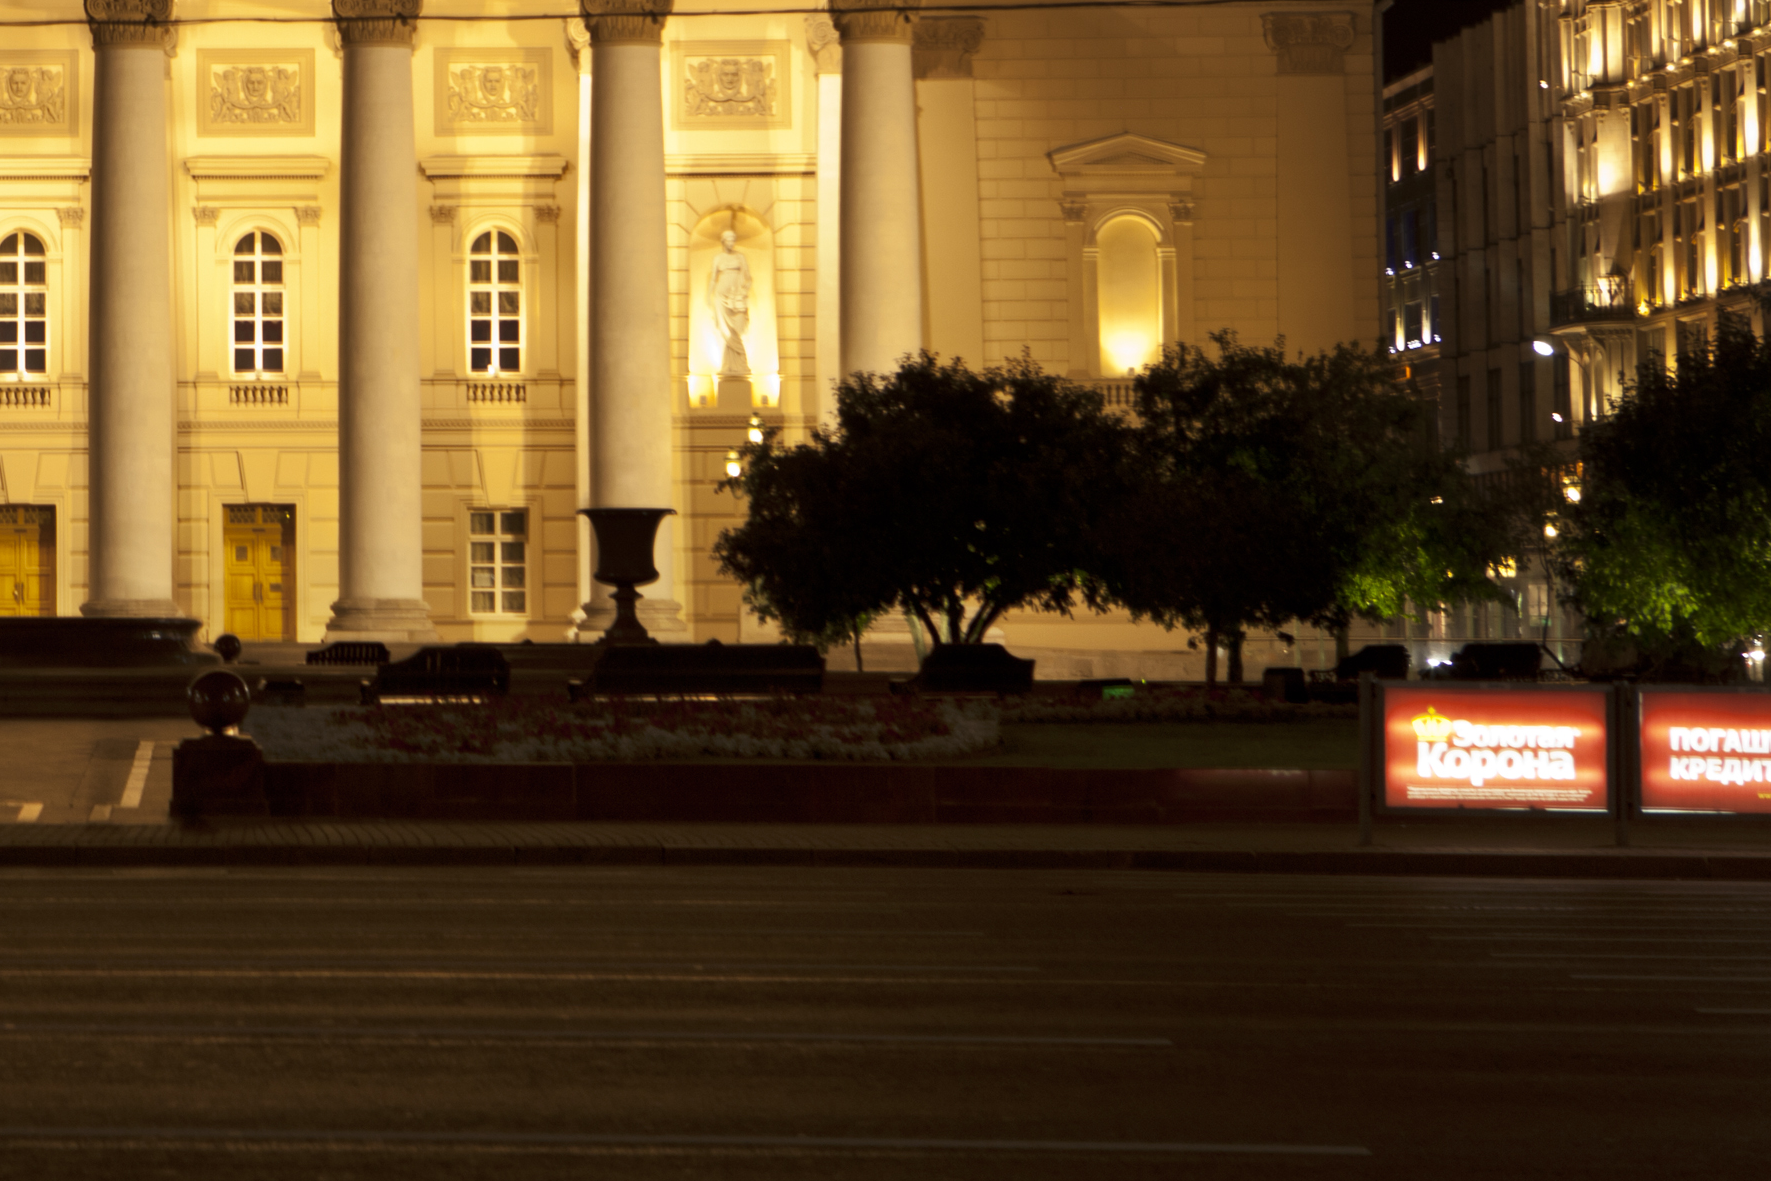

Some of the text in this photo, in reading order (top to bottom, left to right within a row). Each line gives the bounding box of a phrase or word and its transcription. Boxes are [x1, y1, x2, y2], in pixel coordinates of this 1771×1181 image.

[1452, 719, 1577, 748] Золотая
[1669, 726, 1771, 753] ПОГАШ
[1417, 741, 1576, 786] Корона
